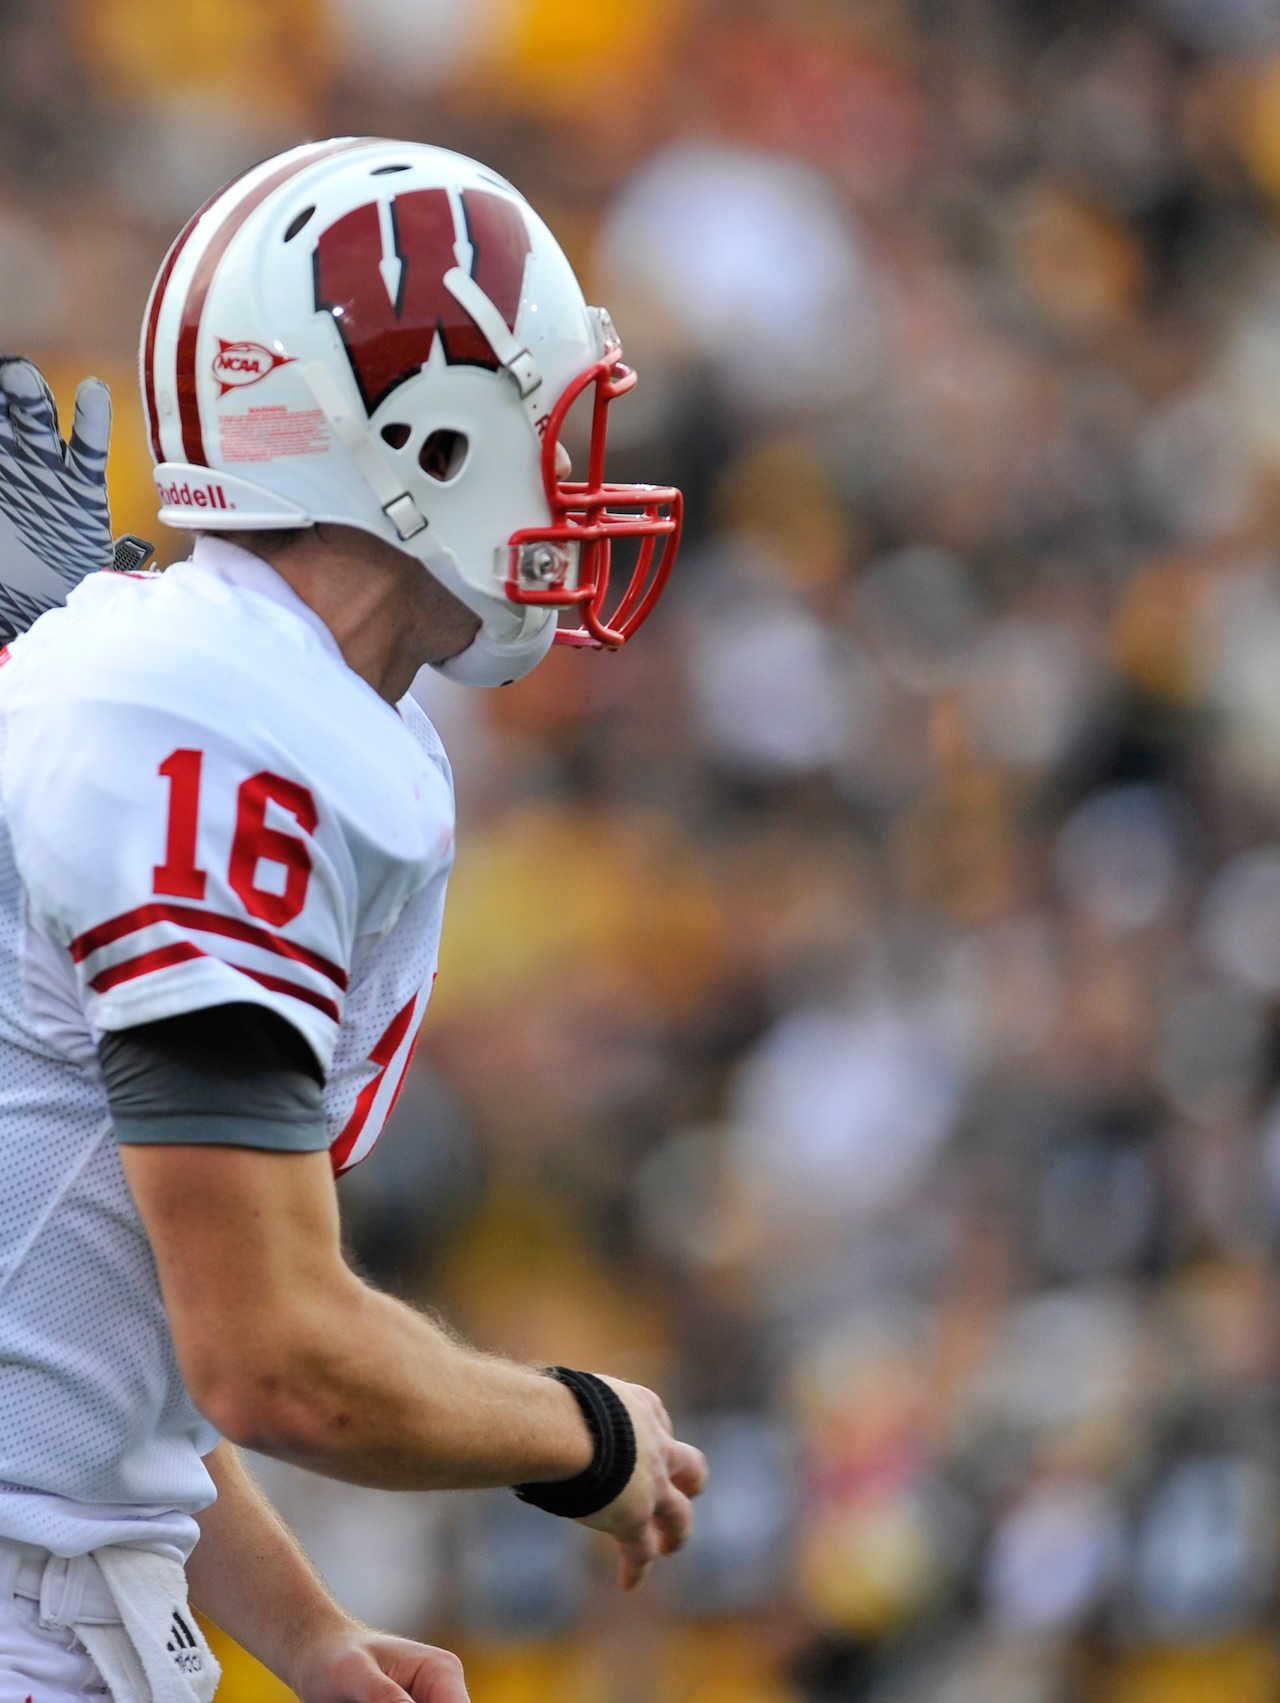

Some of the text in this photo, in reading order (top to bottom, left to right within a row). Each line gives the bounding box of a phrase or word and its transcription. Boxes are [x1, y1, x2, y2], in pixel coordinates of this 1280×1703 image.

[217, 354, 261, 373] NCAA
[313, 187, 532, 419] W
[153, 748, 319, 928] 16
